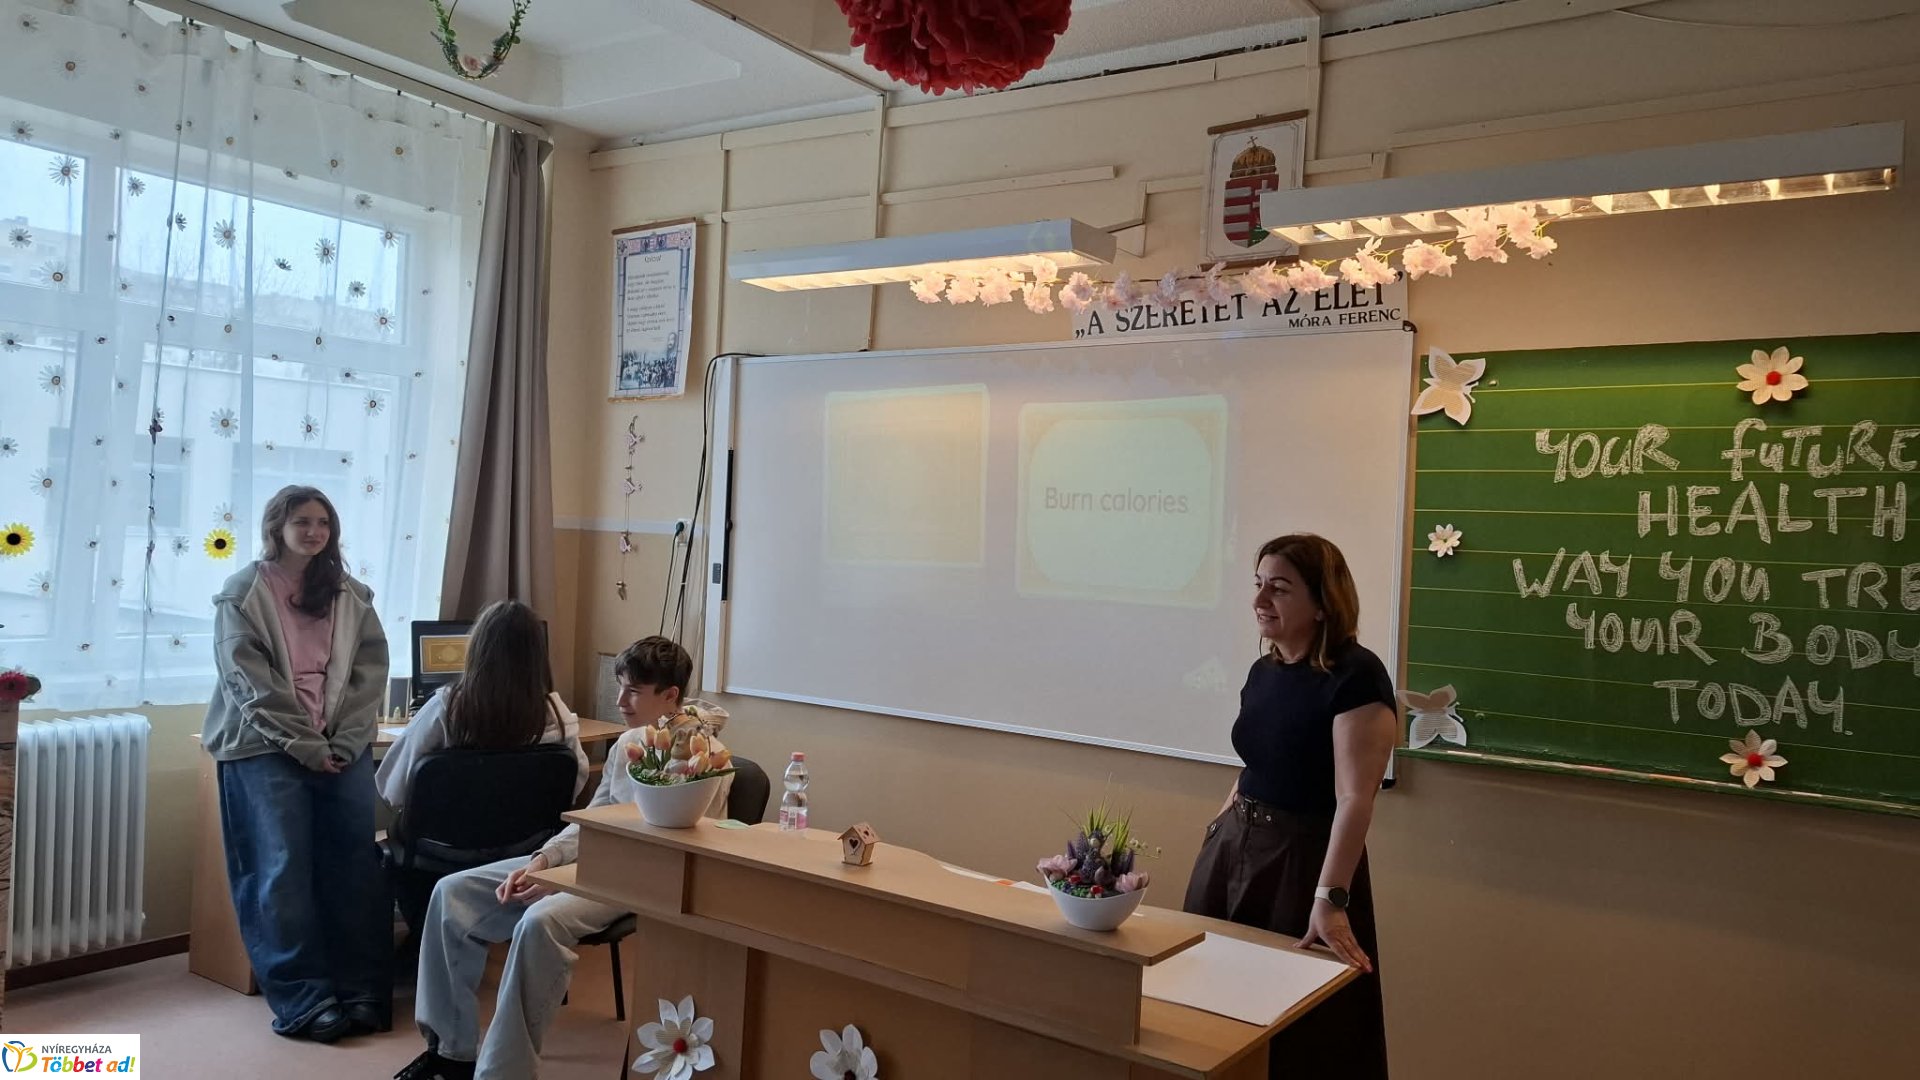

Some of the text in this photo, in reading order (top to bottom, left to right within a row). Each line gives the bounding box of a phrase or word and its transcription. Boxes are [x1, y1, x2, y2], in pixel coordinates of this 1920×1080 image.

[1262, 287, 1301, 317] AZ
[1288, 308, 1401, 328] MÓRA FERENC
[1045, 487, 1189, 514] Burn calories
[1637, 481, 1907, 543] HEALTH
[1512, 547, 1632, 598] WAY
[1741, 612, 1920, 676] BODY
